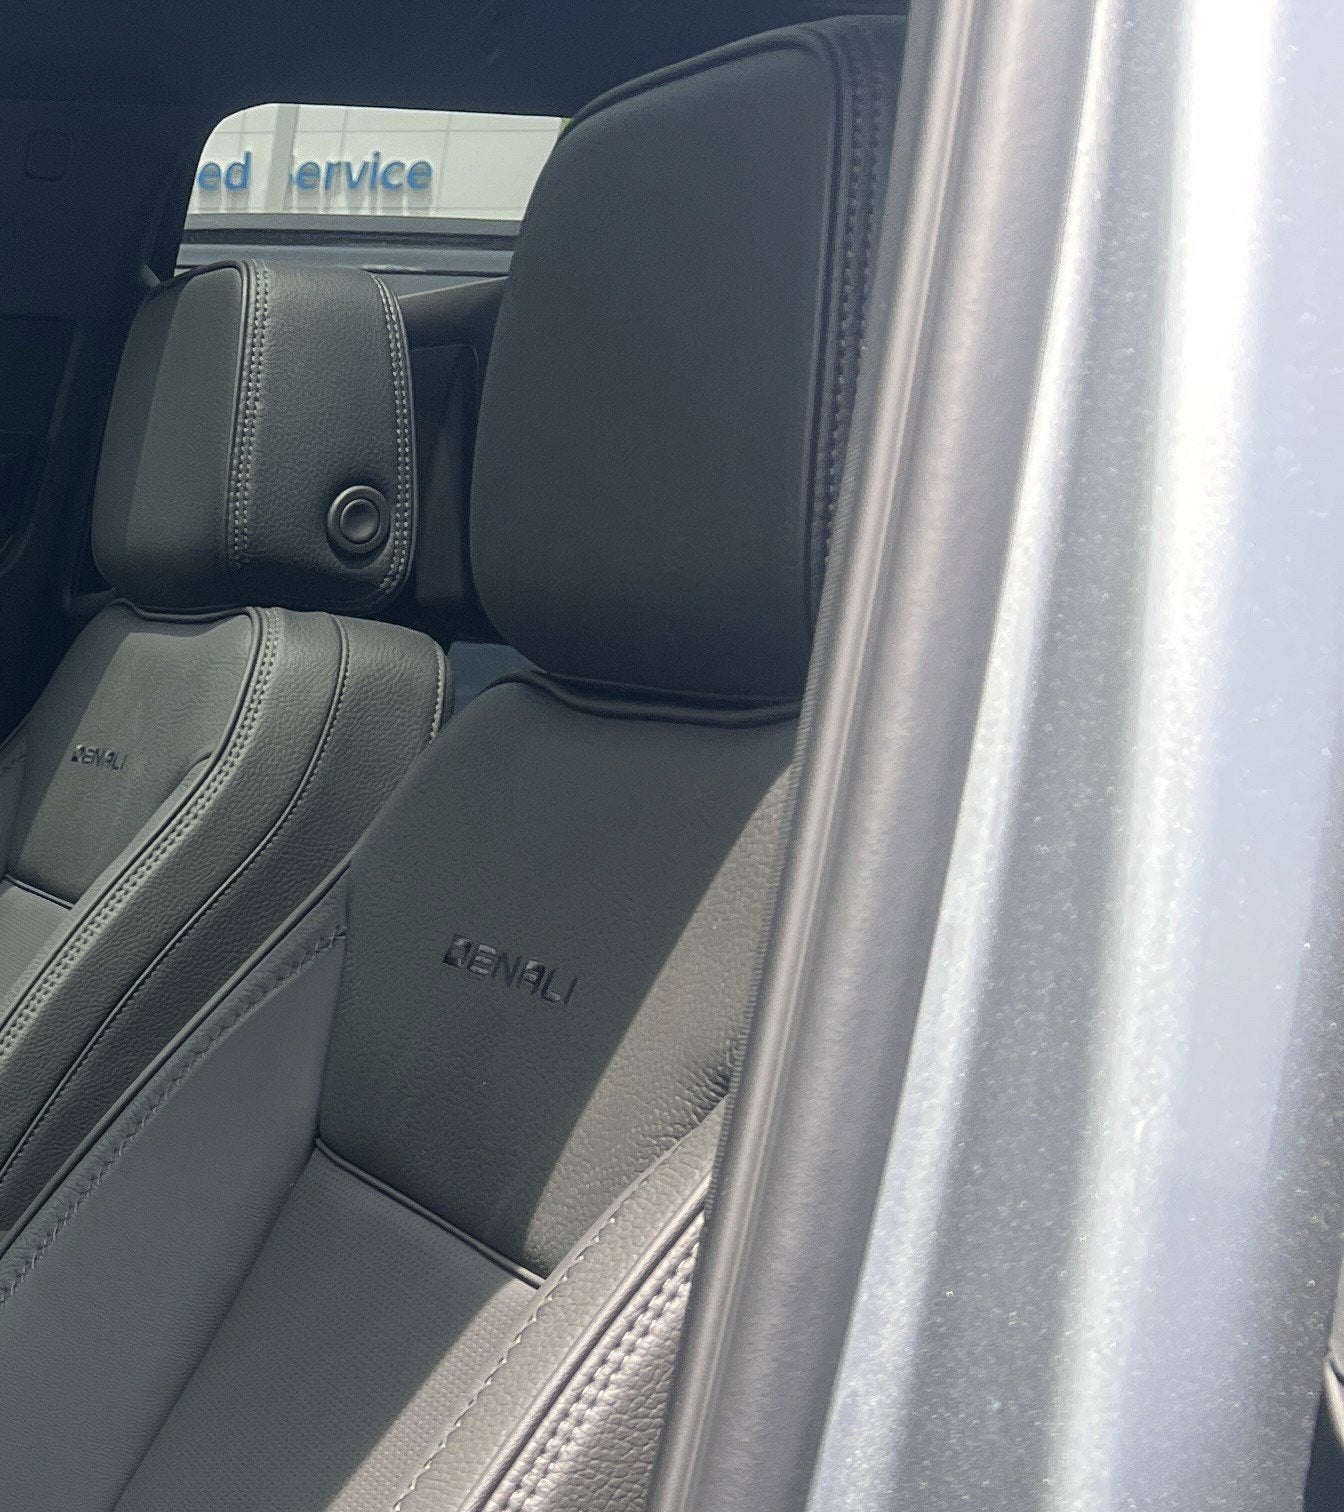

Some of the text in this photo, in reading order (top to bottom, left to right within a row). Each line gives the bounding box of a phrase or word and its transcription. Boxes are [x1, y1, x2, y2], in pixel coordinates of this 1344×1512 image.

[290, 150, 433, 190] ervice
[71, 744, 127, 770] DENALI
[442, 933, 579, 1006] DENALI
